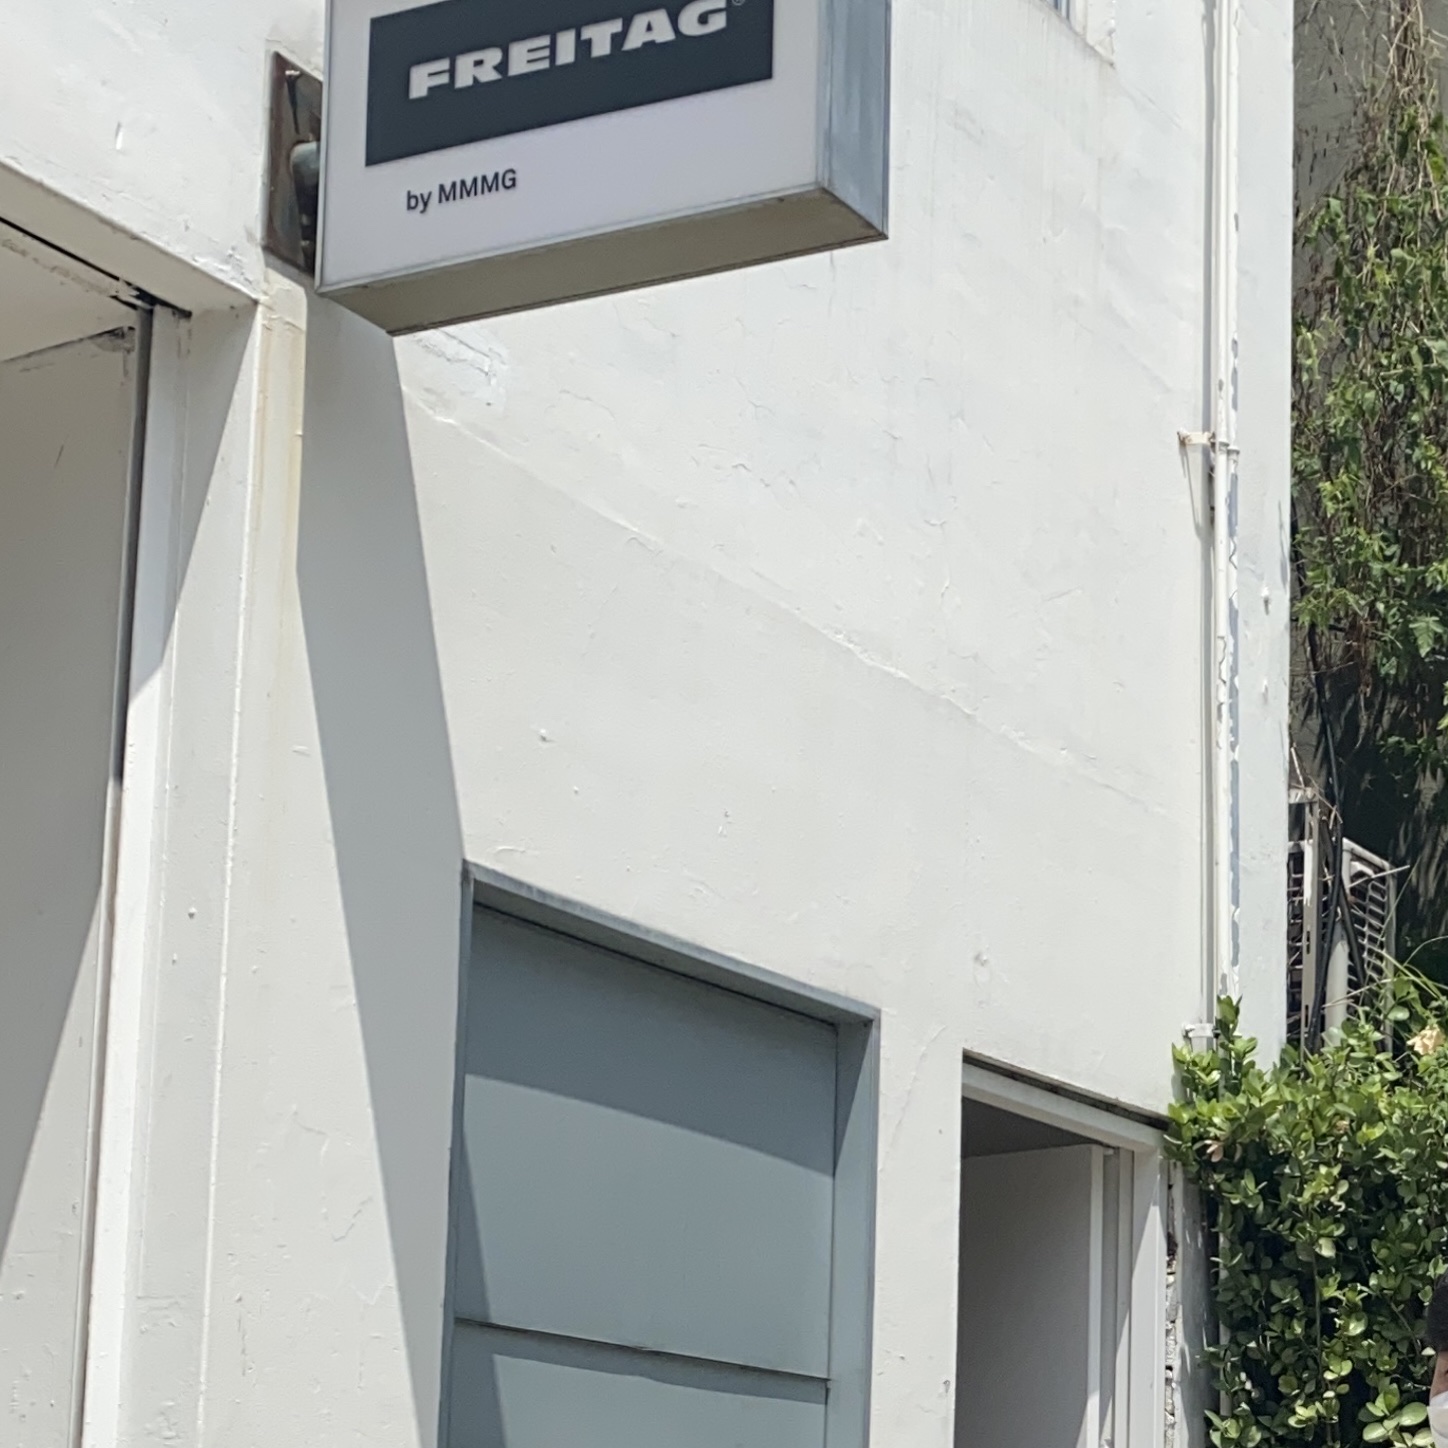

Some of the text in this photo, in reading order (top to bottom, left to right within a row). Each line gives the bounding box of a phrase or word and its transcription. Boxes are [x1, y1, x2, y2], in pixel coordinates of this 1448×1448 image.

[408, 0, 727, 100] FREITAG
[406, 168, 517, 214] by MMMG
